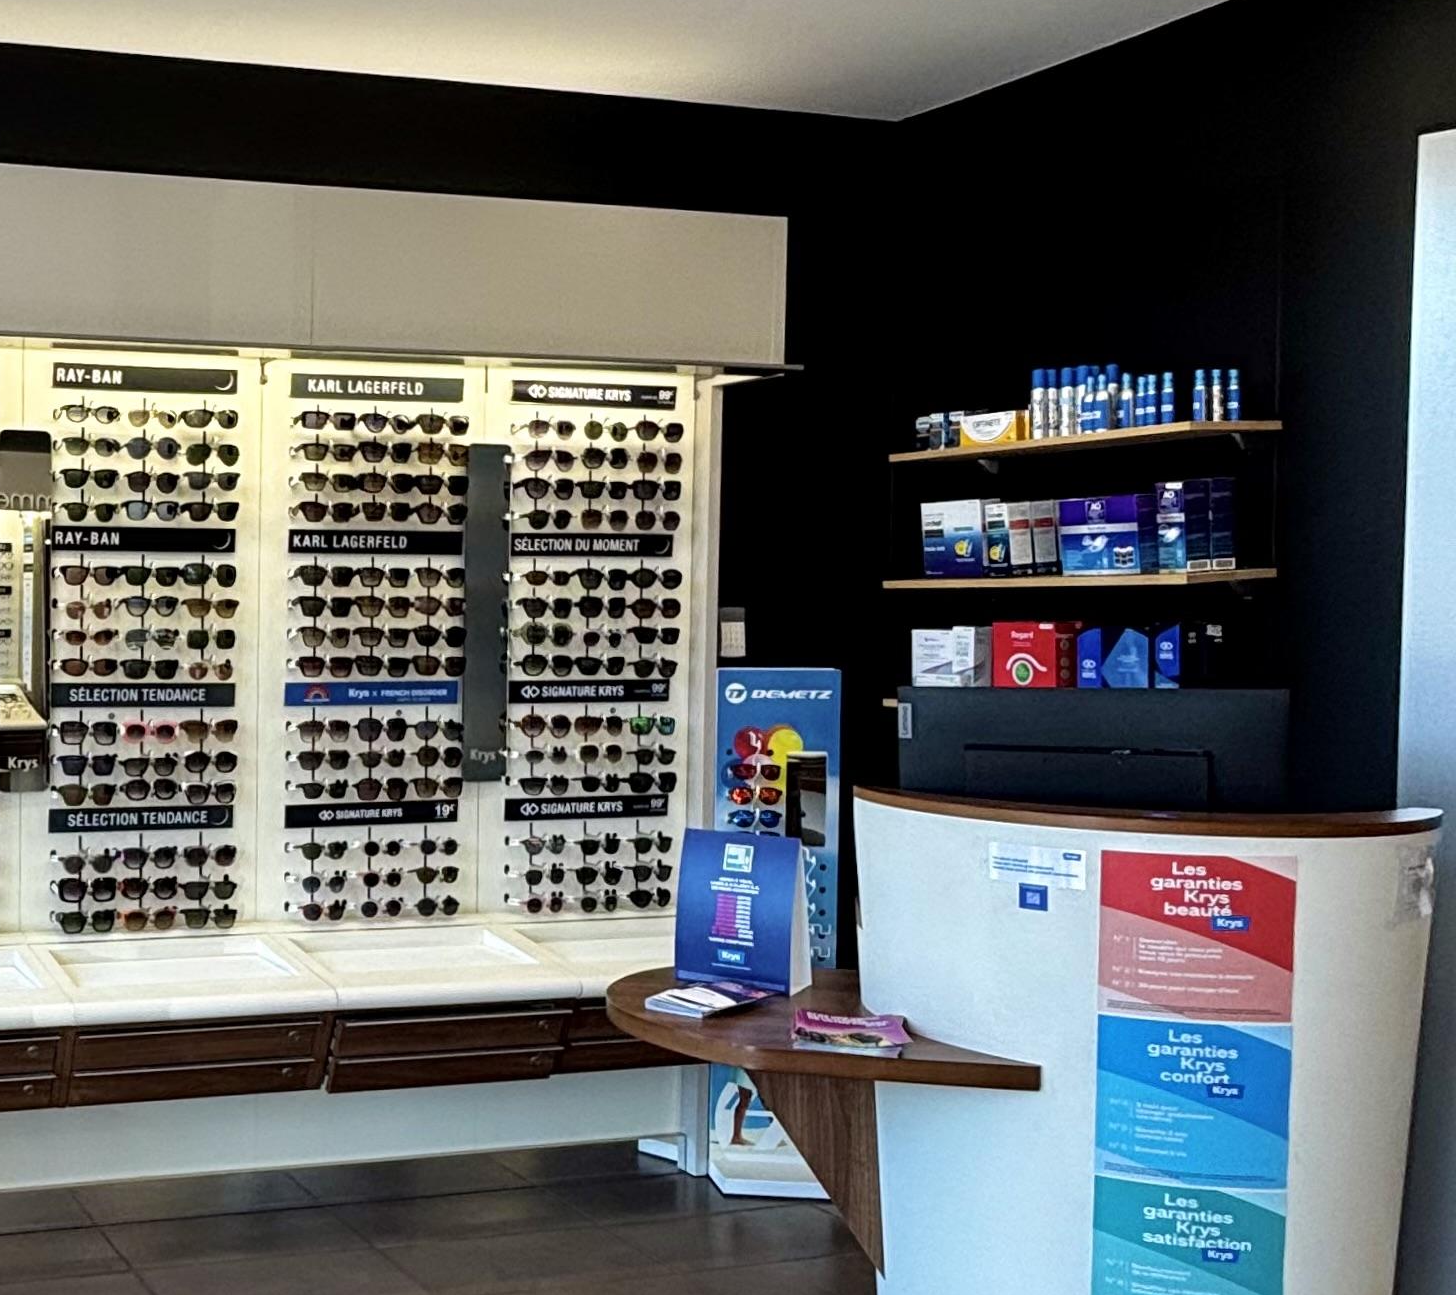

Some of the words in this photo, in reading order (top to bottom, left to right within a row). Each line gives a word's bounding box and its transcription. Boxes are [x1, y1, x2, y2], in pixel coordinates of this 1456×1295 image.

[56, 367, 123, 385] RAY-BAN
[307, 378, 344, 394] KARL
[347, 380, 424, 395] LAGERFELD
[548, 386, 604, 401] SIGNATURE
[605, 388, 632, 403] KRYS
[54, 531, 120, 546] RAY-BAN
[293, 534, 328, 548] KARL
[332, 535, 408, 549] LAGERFELD
[513, 536, 572, 551] SÉLECTION
[575, 538, 590, 551] DU
[593, 538, 640, 552] MOMENT
[69, 686, 138, 702] SÉLECTION
[143, 688, 207, 702] TENDANCE
[348, 687, 370, 699] Krys
[541, 685, 597, 698] SIGNATURE
[598, 685, 625, 697] KRYS
[751, 689, 833, 699] DEMETZ
[469, 748, 496, 763] Krys
[7, 756, 39, 772] Krys
[335, 809, 380, 820] SIGNATURE
[381, 807, 403, 819] KRYS
[540, 802, 595, 815] SIGNATURE
[597, 800, 624, 813] KRYS
[67, 812, 138, 828] SÉLECTION
[143, 810, 208, 825] TENDANCE
[1171, 861, 1207, 876] Les
[1150, 876, 1243, 891] garanties
[1184, 890, 1230, 906] Krys
[1163, 902, 1233, 917] beauté
[1216, 917, 1244, 929] Krys
[1168, 1028, 1203, 1044] Les
[1147, 1043, 1239, 1059] garanties
[1180, 1057, 1227, 1073] Krys
[1160, 1071, 1231, 1085] confort
[1212, 1085, 1239, 1097] Krys
[1163, 1193, 1199, 1208] Les
[1143, 1206, 1234, 1224] garanties
[1175, 1221, 1221, 1237] Krys
[1142, 1232, 1252, 1252] satisfaction
[1207, 1250, 1234, 1261] Krys
